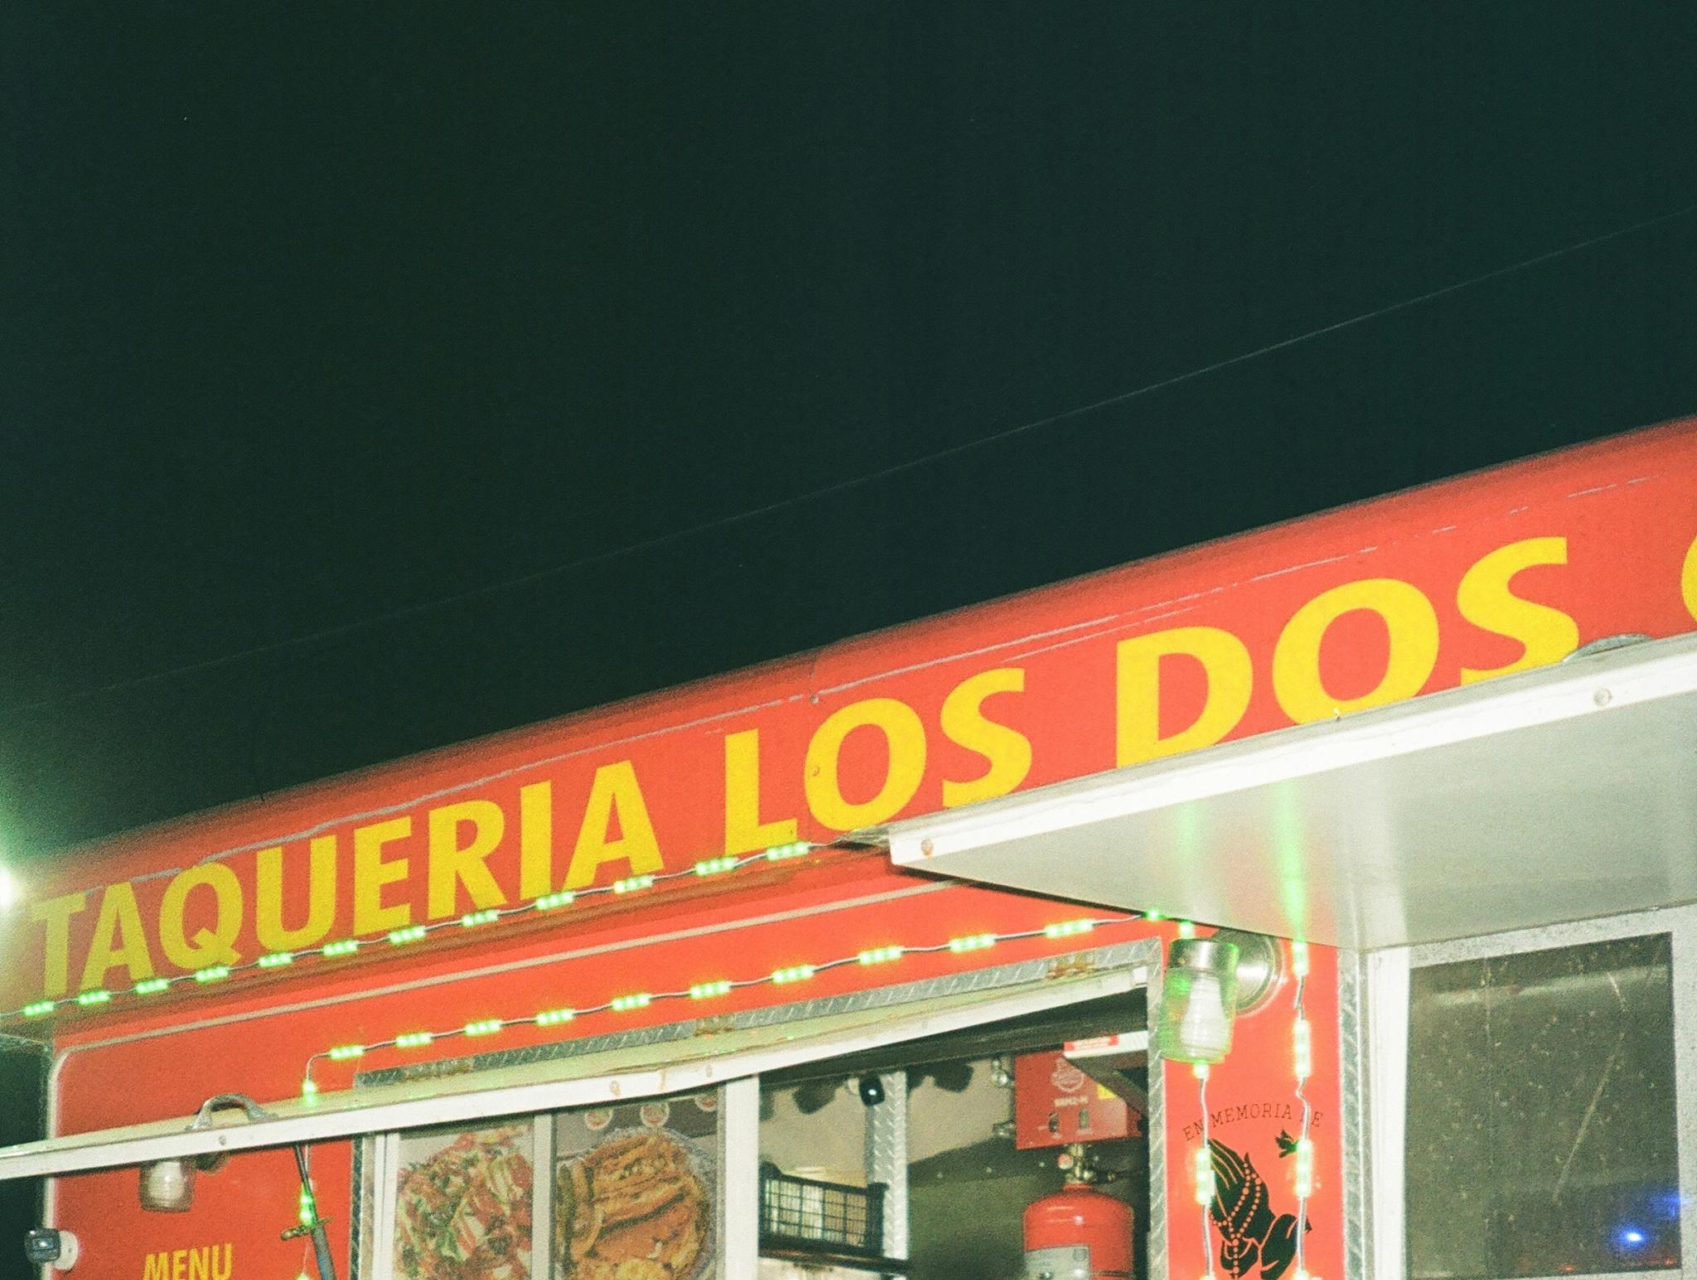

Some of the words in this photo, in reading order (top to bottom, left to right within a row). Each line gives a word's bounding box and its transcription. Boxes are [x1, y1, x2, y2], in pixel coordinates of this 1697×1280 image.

[33, 760, 664, 998] TAQUERIA
[724, 668, 1033, 860] LOS
[1117, 536, 1580, 768] DOS
[1182, 1120, 1206, 1142] EN
[1211, 1103, 1293, 1128] MEMORIA
[1300, 1111, 1324, 1128] E
